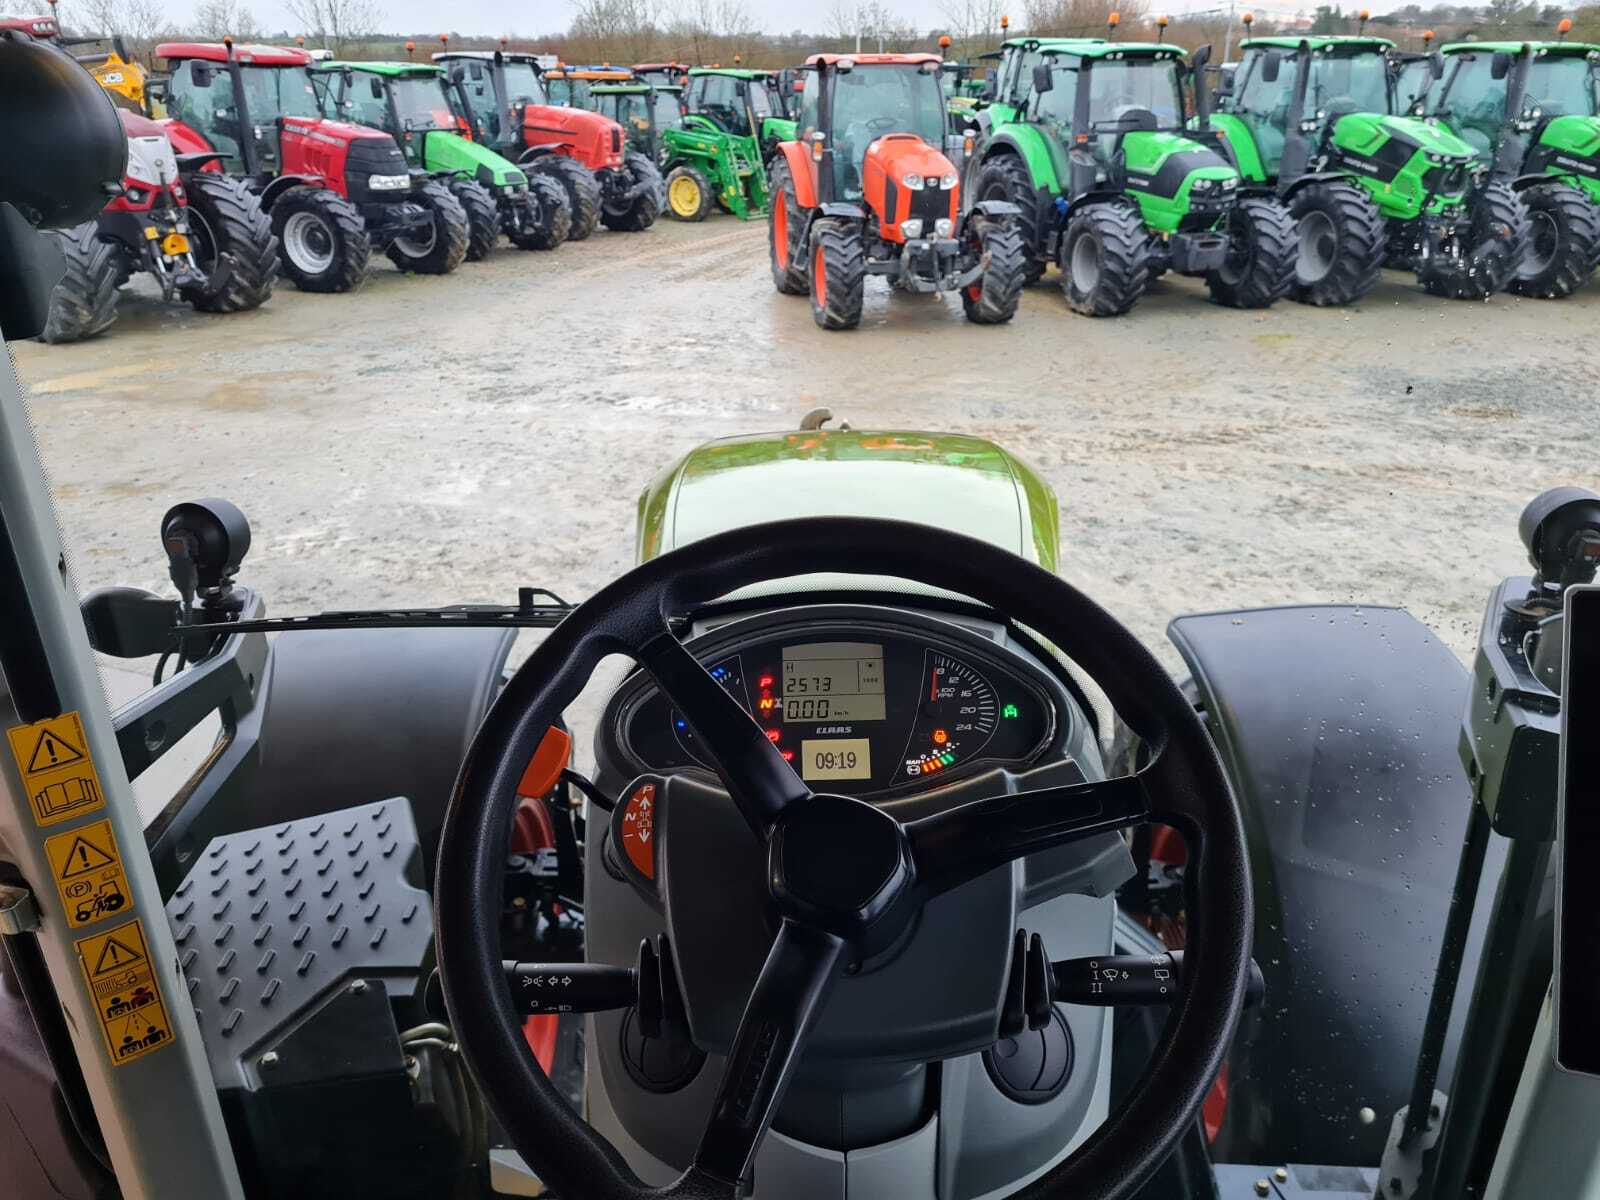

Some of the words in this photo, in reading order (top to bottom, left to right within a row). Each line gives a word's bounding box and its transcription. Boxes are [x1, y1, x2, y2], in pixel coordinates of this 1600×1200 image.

[760, 677, 772, 687] P
[786, 677, 832, 692] 2573
[960, 689, 972, 697] 16
[760, 698, 773, 709] N
[815, 726, 853, 735] CLAAS
[955, 723, 972, 731] 24
[815, 751, 857, 770] 09:19
[642, 785, 654, 794] P
[625, 812, 637, 821] N
